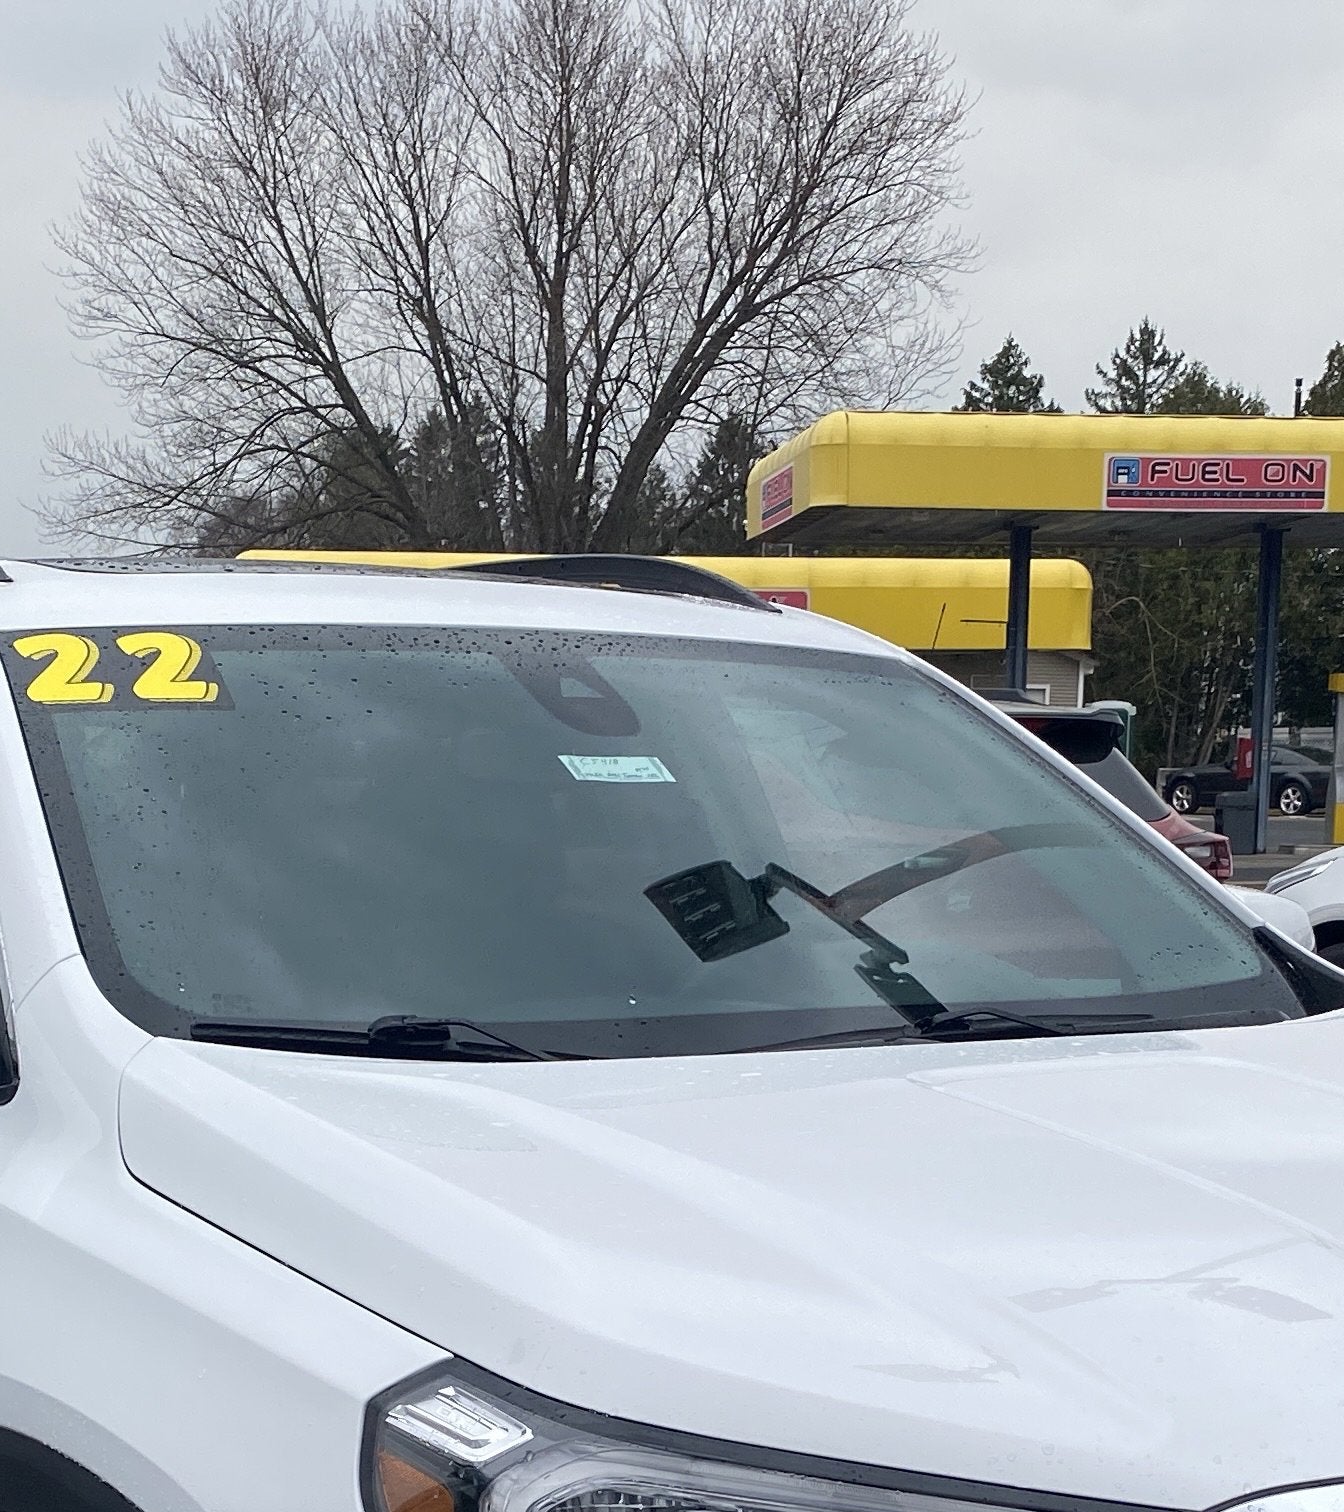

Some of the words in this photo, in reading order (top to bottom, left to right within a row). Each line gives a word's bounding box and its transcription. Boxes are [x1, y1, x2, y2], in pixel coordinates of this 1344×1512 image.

[1149, 460, 1247, 484] FUEL
[1262, 460, 1317, 484] ON
[1120, 490, 1243, 498] CONVENIENCE
[1255, 490, 1306, 498] STORE
[13, 632, 219, 705] 22
